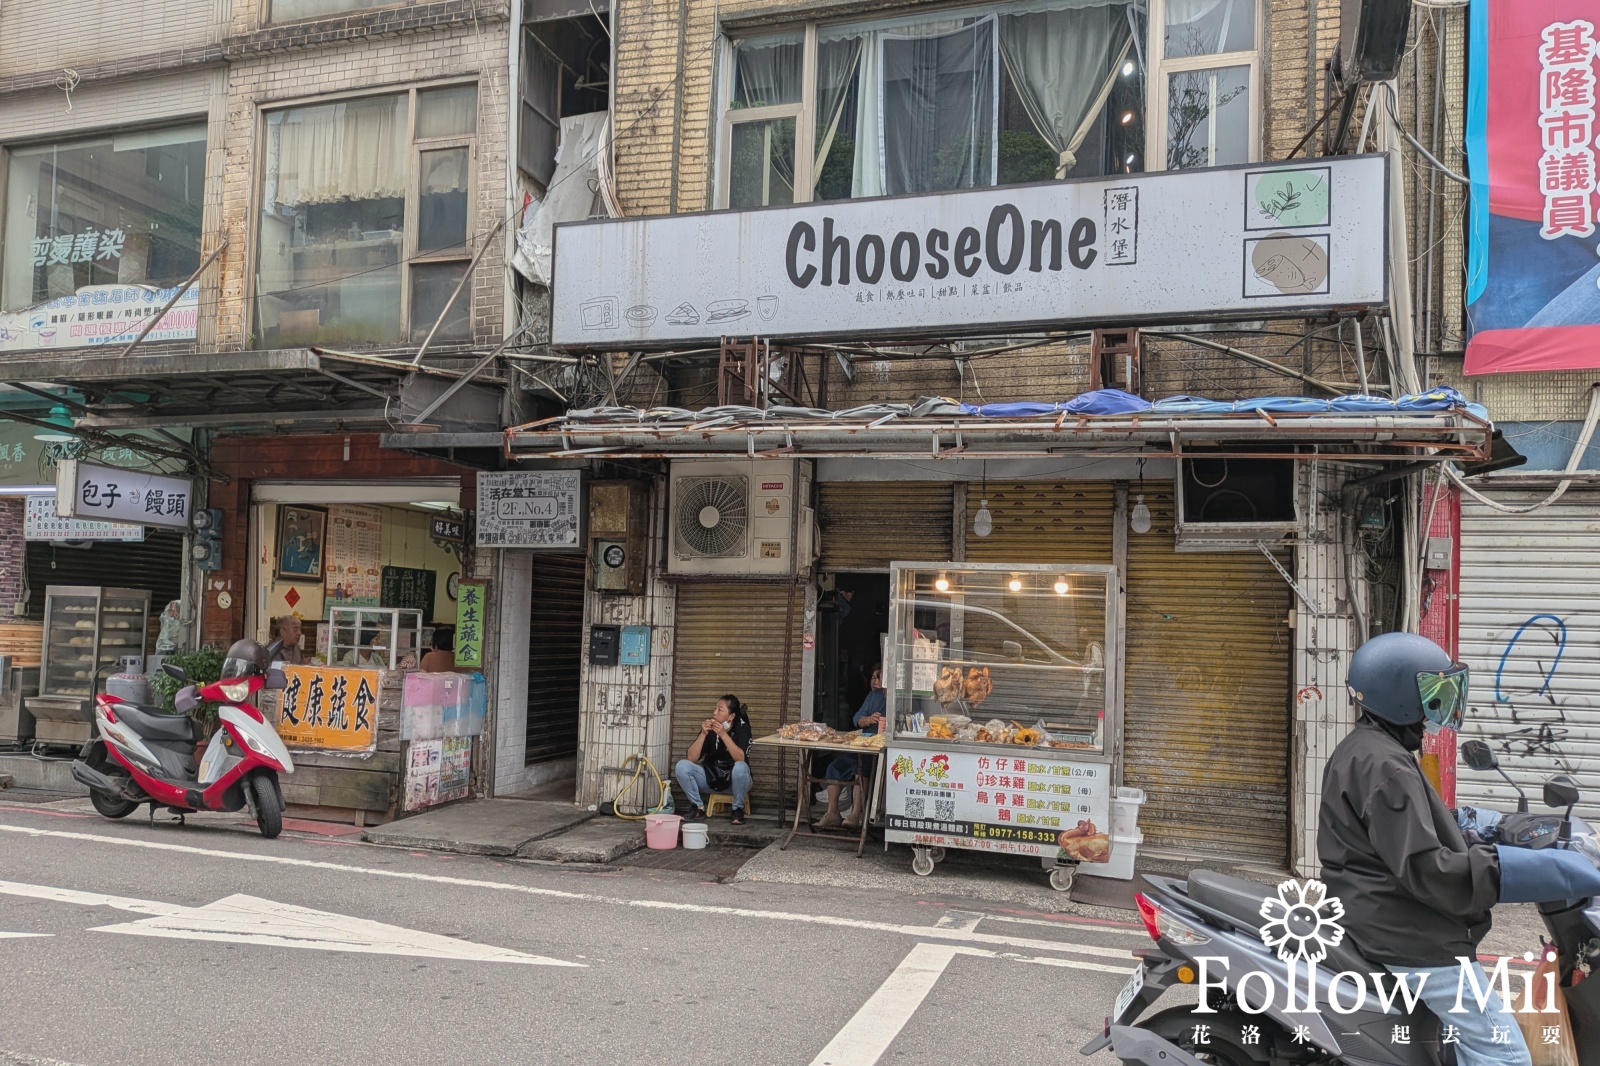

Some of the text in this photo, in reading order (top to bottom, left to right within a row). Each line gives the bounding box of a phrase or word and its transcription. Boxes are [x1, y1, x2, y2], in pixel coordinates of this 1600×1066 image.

[1541, 20, 1594, 238] 基隆市議員
[1110, 192, 1132, 260] 潛水堡
[30, 228, 126, 267] 剪燙護染
[785, 203, 1098, 290] ChooseOne
[886, 288, 925, 301] 熱壓吐司
[937, 285, 958, 297] 甜點
[1003, 281, 1023, 293] 飲品
[81, 479, 122, 510] 包子
[144, 489, 187, 519] 饅頭
[489, 487, 536, 500] 活在當下
[502, 501, 552, 516] 2F.,No.4
[434, 521, 460, 537] 好美味
[459, 585, 480, 663] 養生蔬食
[281, 671, 376, 734] 健康蔬食
[894, 754, 949, 785] 雞大娘
[977, 756, 1026, 773] 仿仔雞
[1071, 767, 1097, 778] (公/母)
[985, 774, 1026, 790] 珍珠雞
[1077, 786, 1092, 796] (母)
[998, 808, 1011, 822] 鵝
[1077, 804, 1091, 814] (母)
[989, 827, 1055, 842] 0977-158-333
